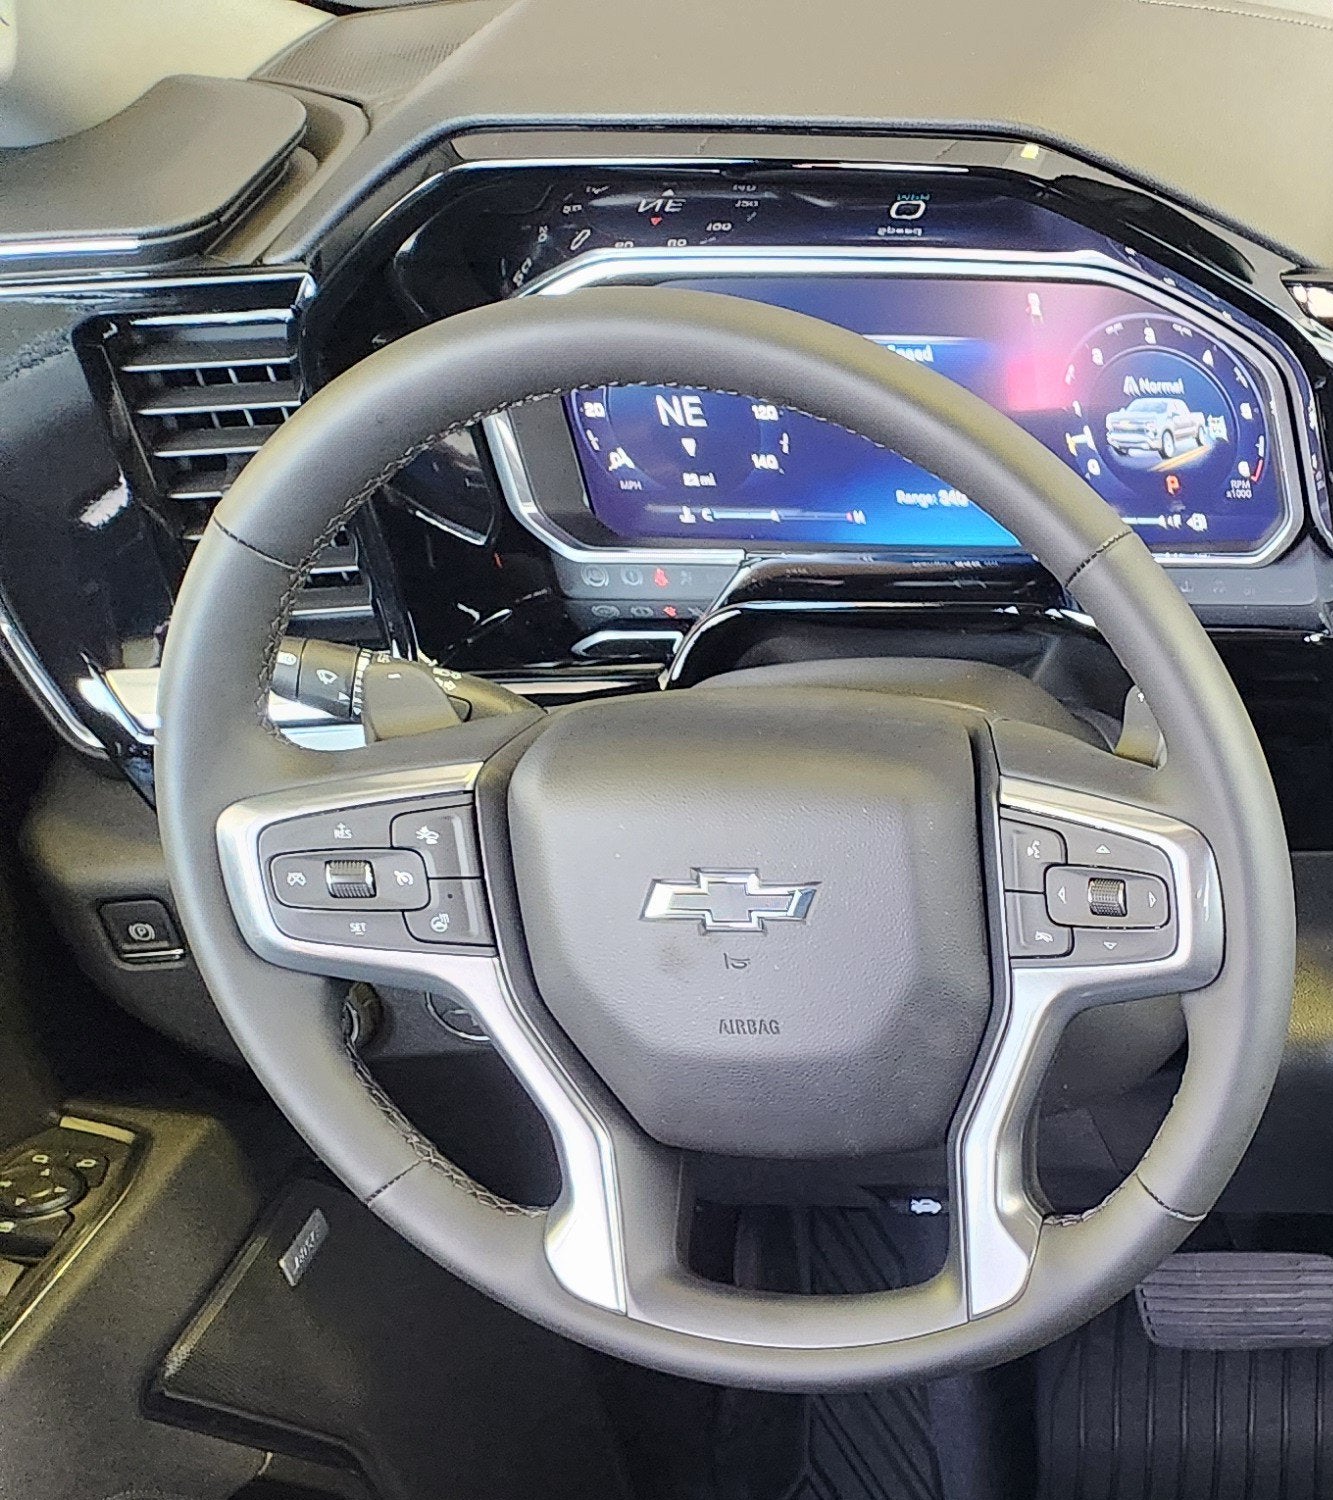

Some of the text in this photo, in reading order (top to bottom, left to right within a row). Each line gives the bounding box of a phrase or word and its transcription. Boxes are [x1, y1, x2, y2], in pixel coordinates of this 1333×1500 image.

[1139, 376, 1184, 395] Normal
[583, 402, 605, 418] 20
[655, 394, 707, 427] NE
[752, 405, 779, 421] 120
[751, 453, 779, 470] 140
[620, 480, 642, 490] MPH
[1230, 479, 1251, 489] RPM
[349, 922, 366, 932] SET
[719, 1019, 780, 1035] AIRBAG
